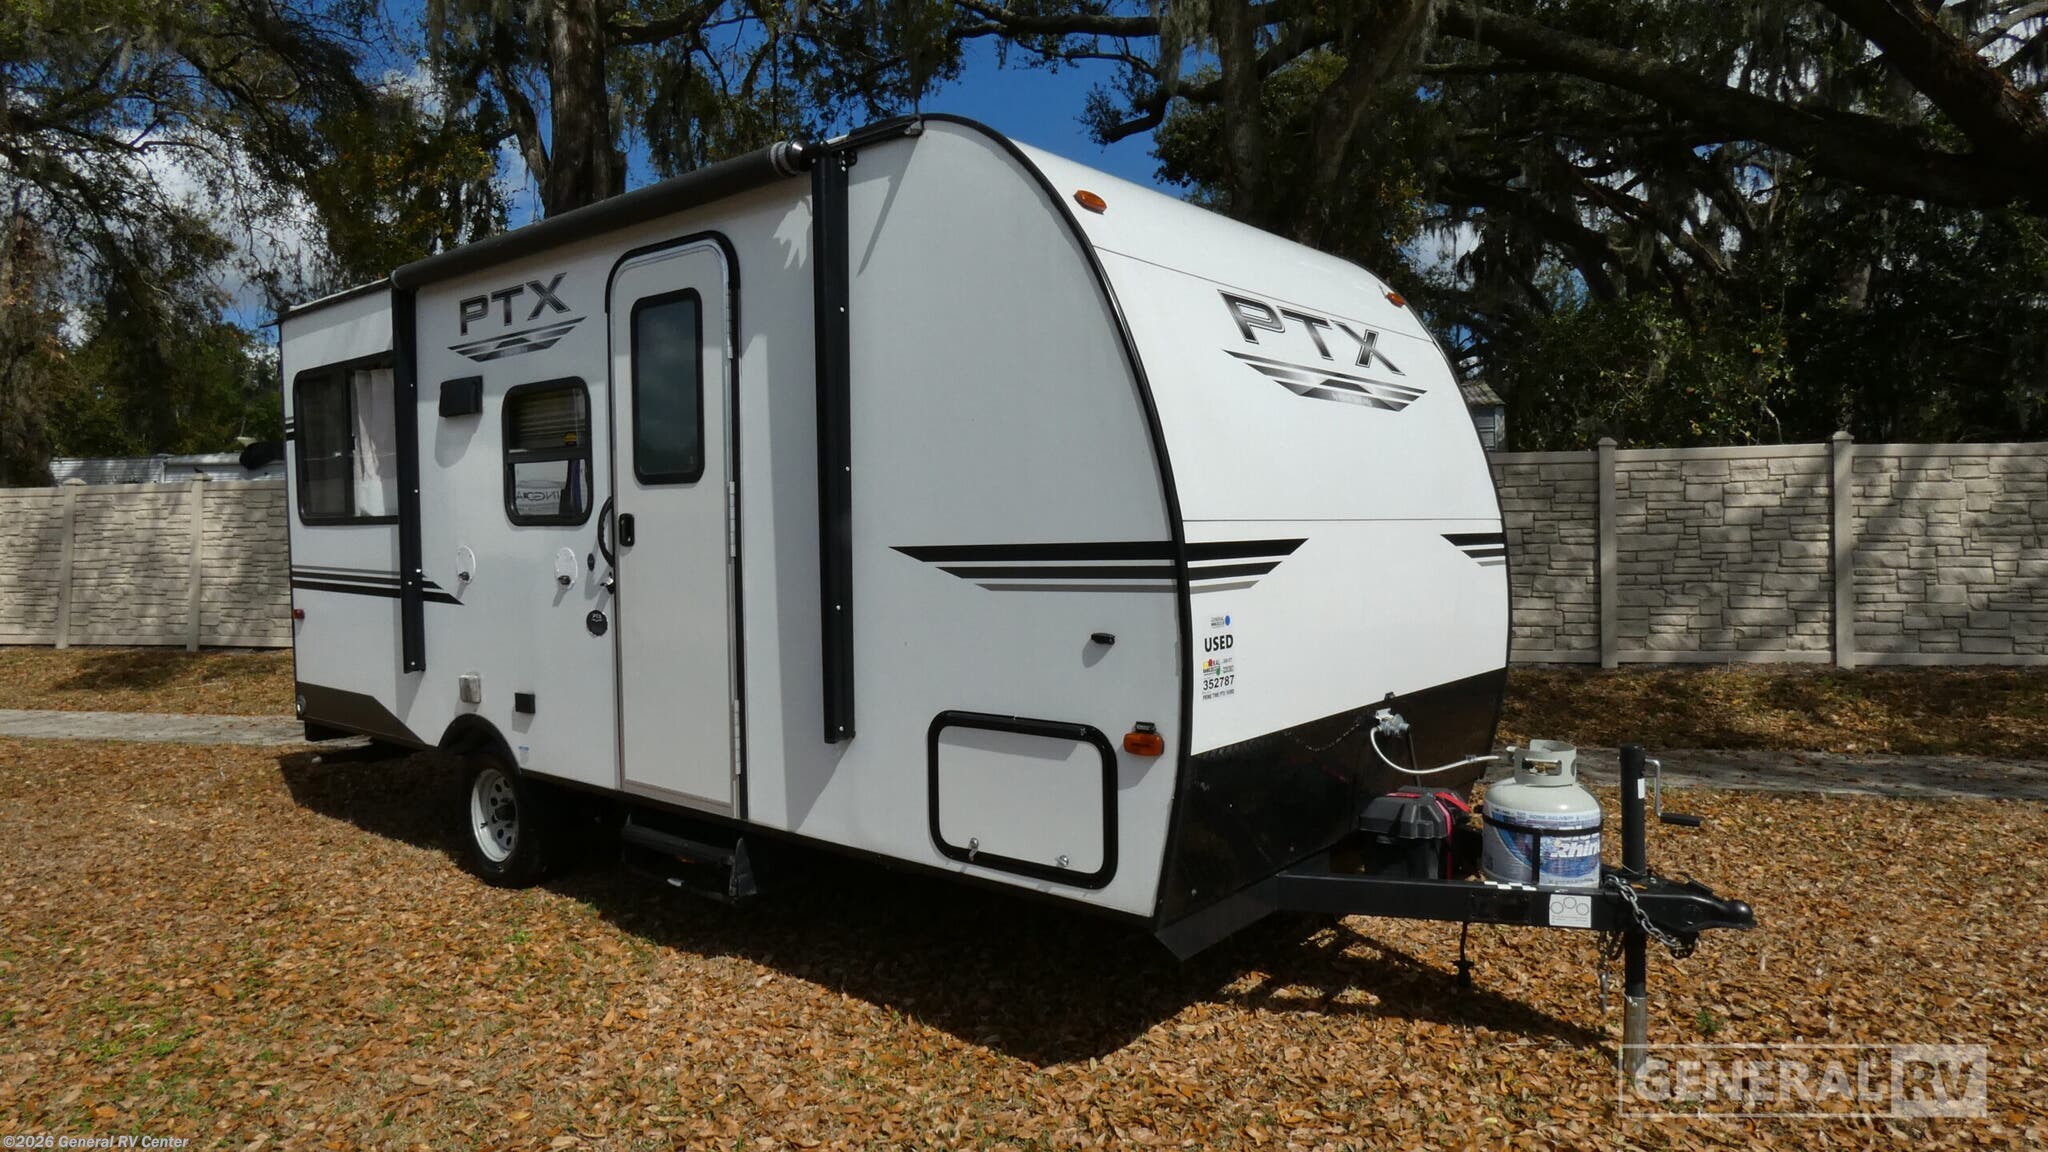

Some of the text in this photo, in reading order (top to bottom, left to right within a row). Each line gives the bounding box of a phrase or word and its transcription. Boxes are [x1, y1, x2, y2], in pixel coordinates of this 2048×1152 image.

[460, 272, 571, 336] PTX
[1217, 289, 1406, 376] PTX
[1204, 634, 1234, 652] USED
[1203, 675, 1235, 691] 352787
[1549, 840, 1600, 858] Rhin
